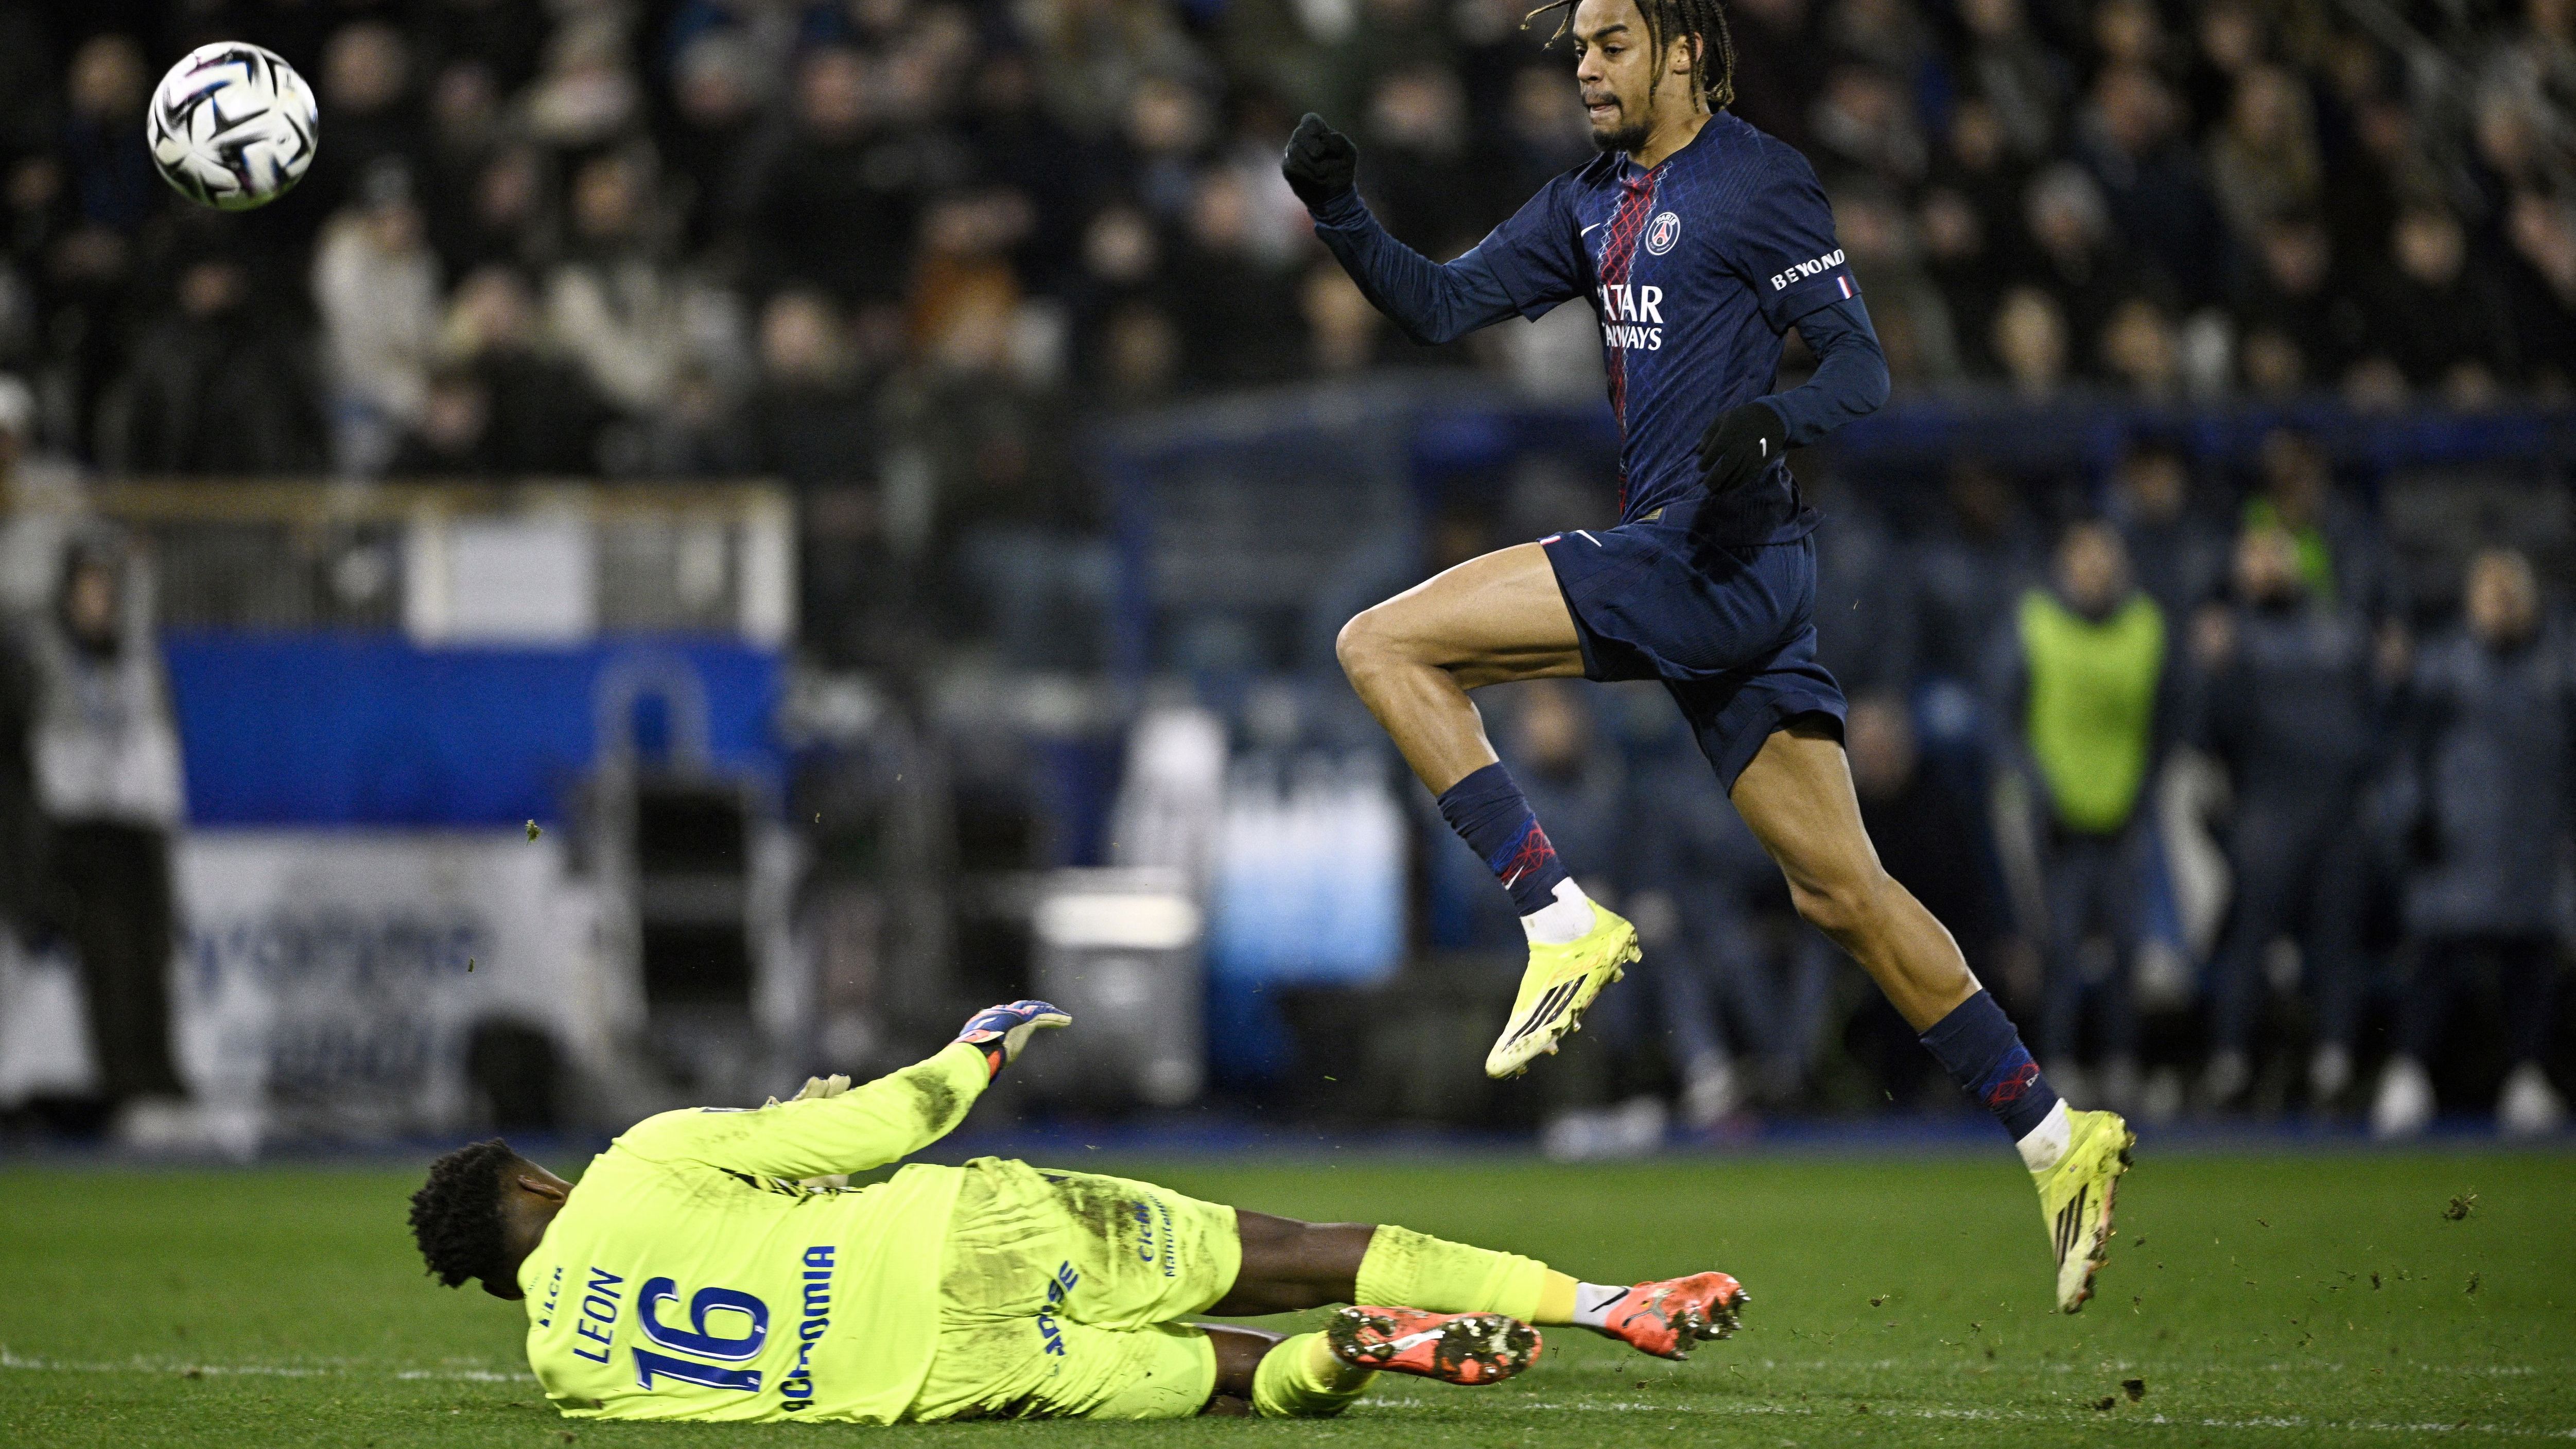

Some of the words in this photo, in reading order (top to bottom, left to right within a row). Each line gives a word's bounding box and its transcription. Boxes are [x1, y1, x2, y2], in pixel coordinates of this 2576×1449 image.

[1656, 214, 1677, 225] PARIS
[1770, 249, 1845, 291] BEYOND
[1597, 284, 1664, 324] ATAR
[573, 1266, 624, 1364] LEON
[631, 1276, 770, 1392] 16
